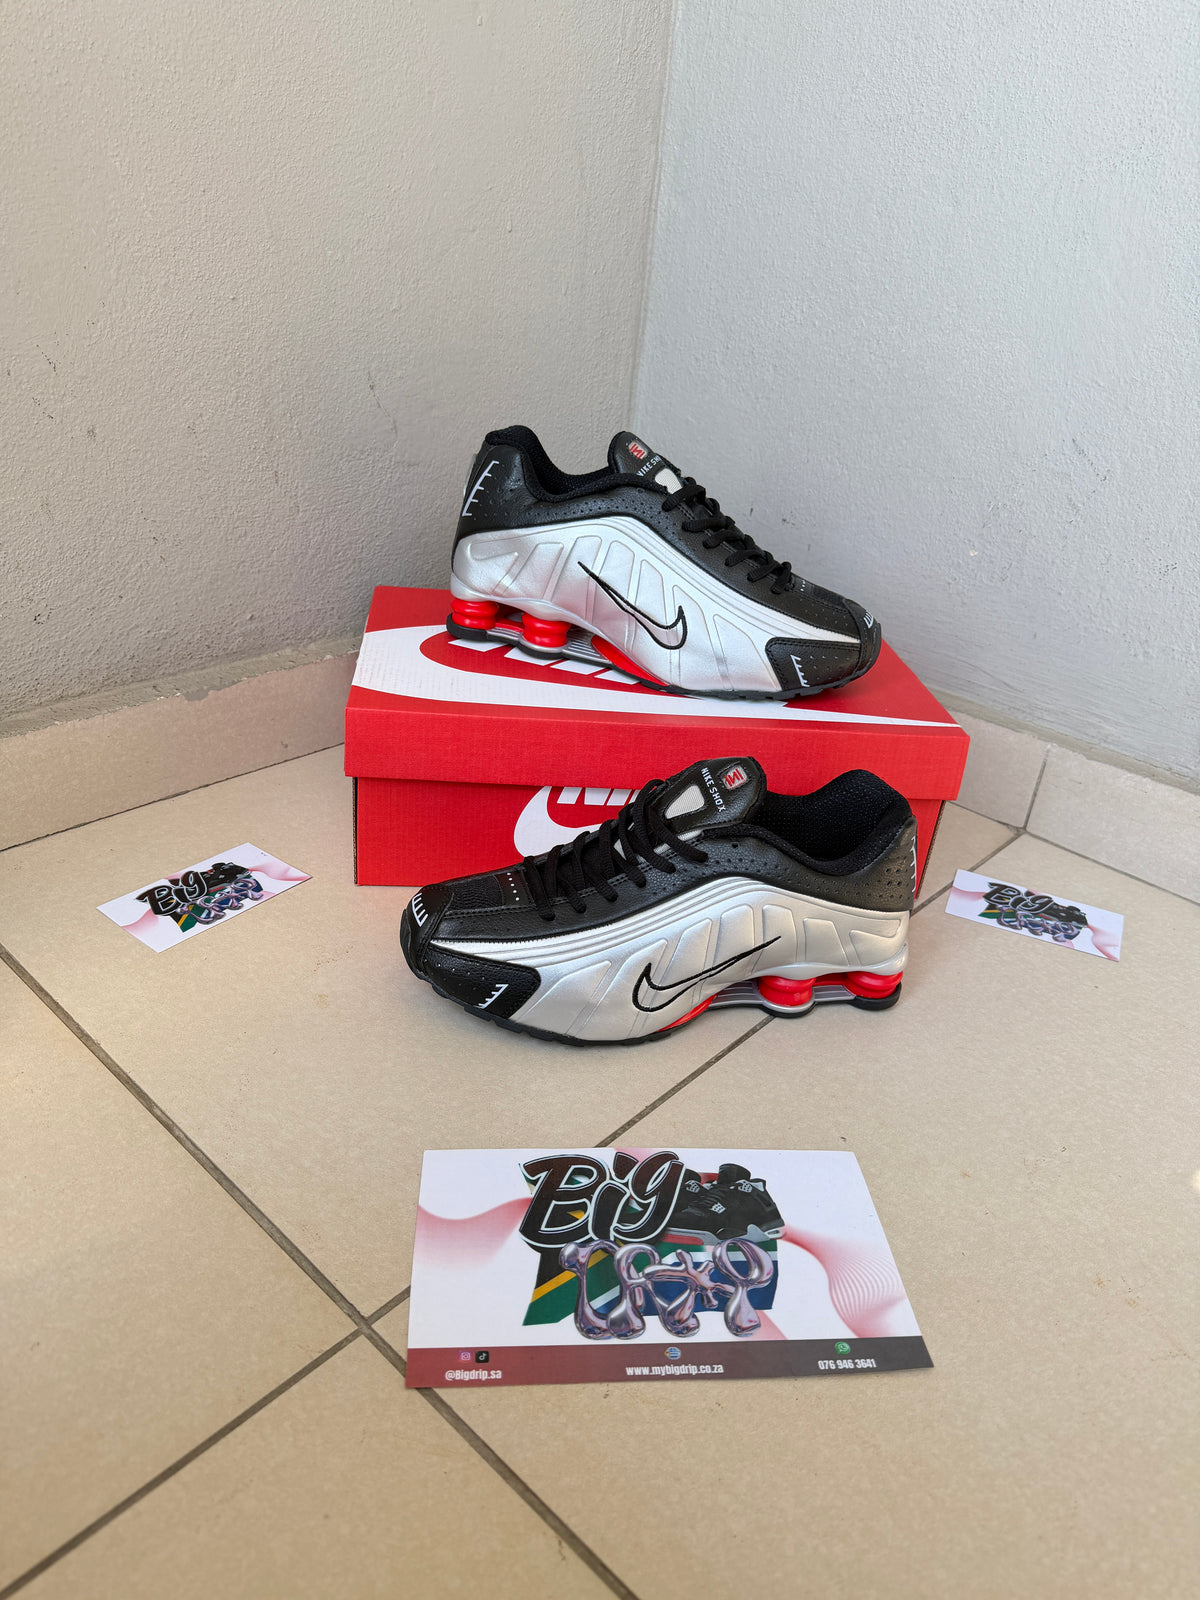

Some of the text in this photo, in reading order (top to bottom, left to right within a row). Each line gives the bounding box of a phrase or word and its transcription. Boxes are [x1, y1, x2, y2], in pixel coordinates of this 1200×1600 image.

[701, 767, 726, 812] NIKE SHOX
[135, 870, 208, 916] Big
[982, 882, 1055, 914] Big
[519, 1151, 685, 1248] Big
[444, 1368, 503, 1382] @Bigdrip.sa
[625, 1363, 725, 1376] www.mybigdrip.co.za
[817, 1358, 877, 1370] 076 946 3641
